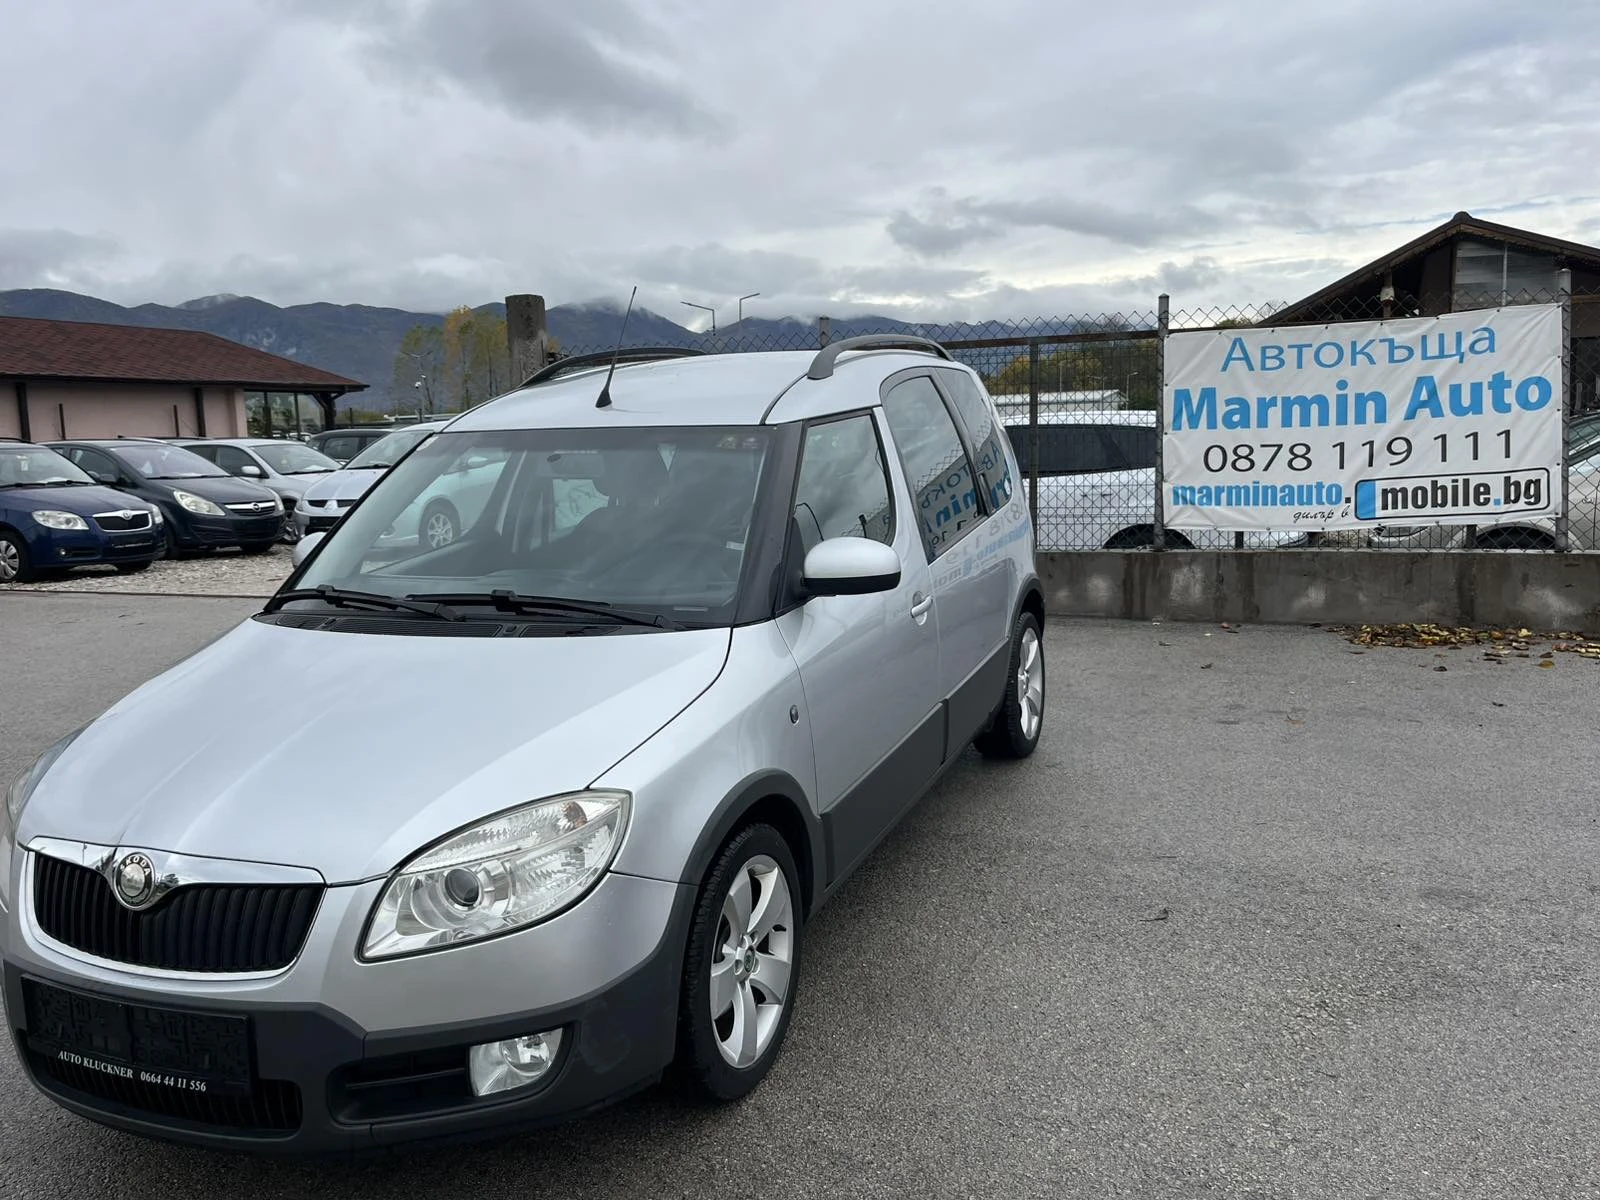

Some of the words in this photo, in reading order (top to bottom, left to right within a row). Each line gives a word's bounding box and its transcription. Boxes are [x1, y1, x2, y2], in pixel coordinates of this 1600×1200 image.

[1220, 326, 1496, 372] Автокъща
[1171, 379, 1387, 431] Marmin
[1404, 370, 1552, 421] Auto
[1203, 443, 1312, 473] 0878
[1332, 436, 1413, 469] 119
[1433, 428, 1512, 463] 111
[1381, 476, 1542, 511] mobile.bg
[58, 1050, 82, 1065] AUTO
[83, 1057, 133, 1079] KLUCKNER
[140, 1071, 161, 1084] 0664
[164, 1076, 174, 1087] 44
[177, 1078, 187, 1089] 11
[190, 1080, 207, 1092] 556
